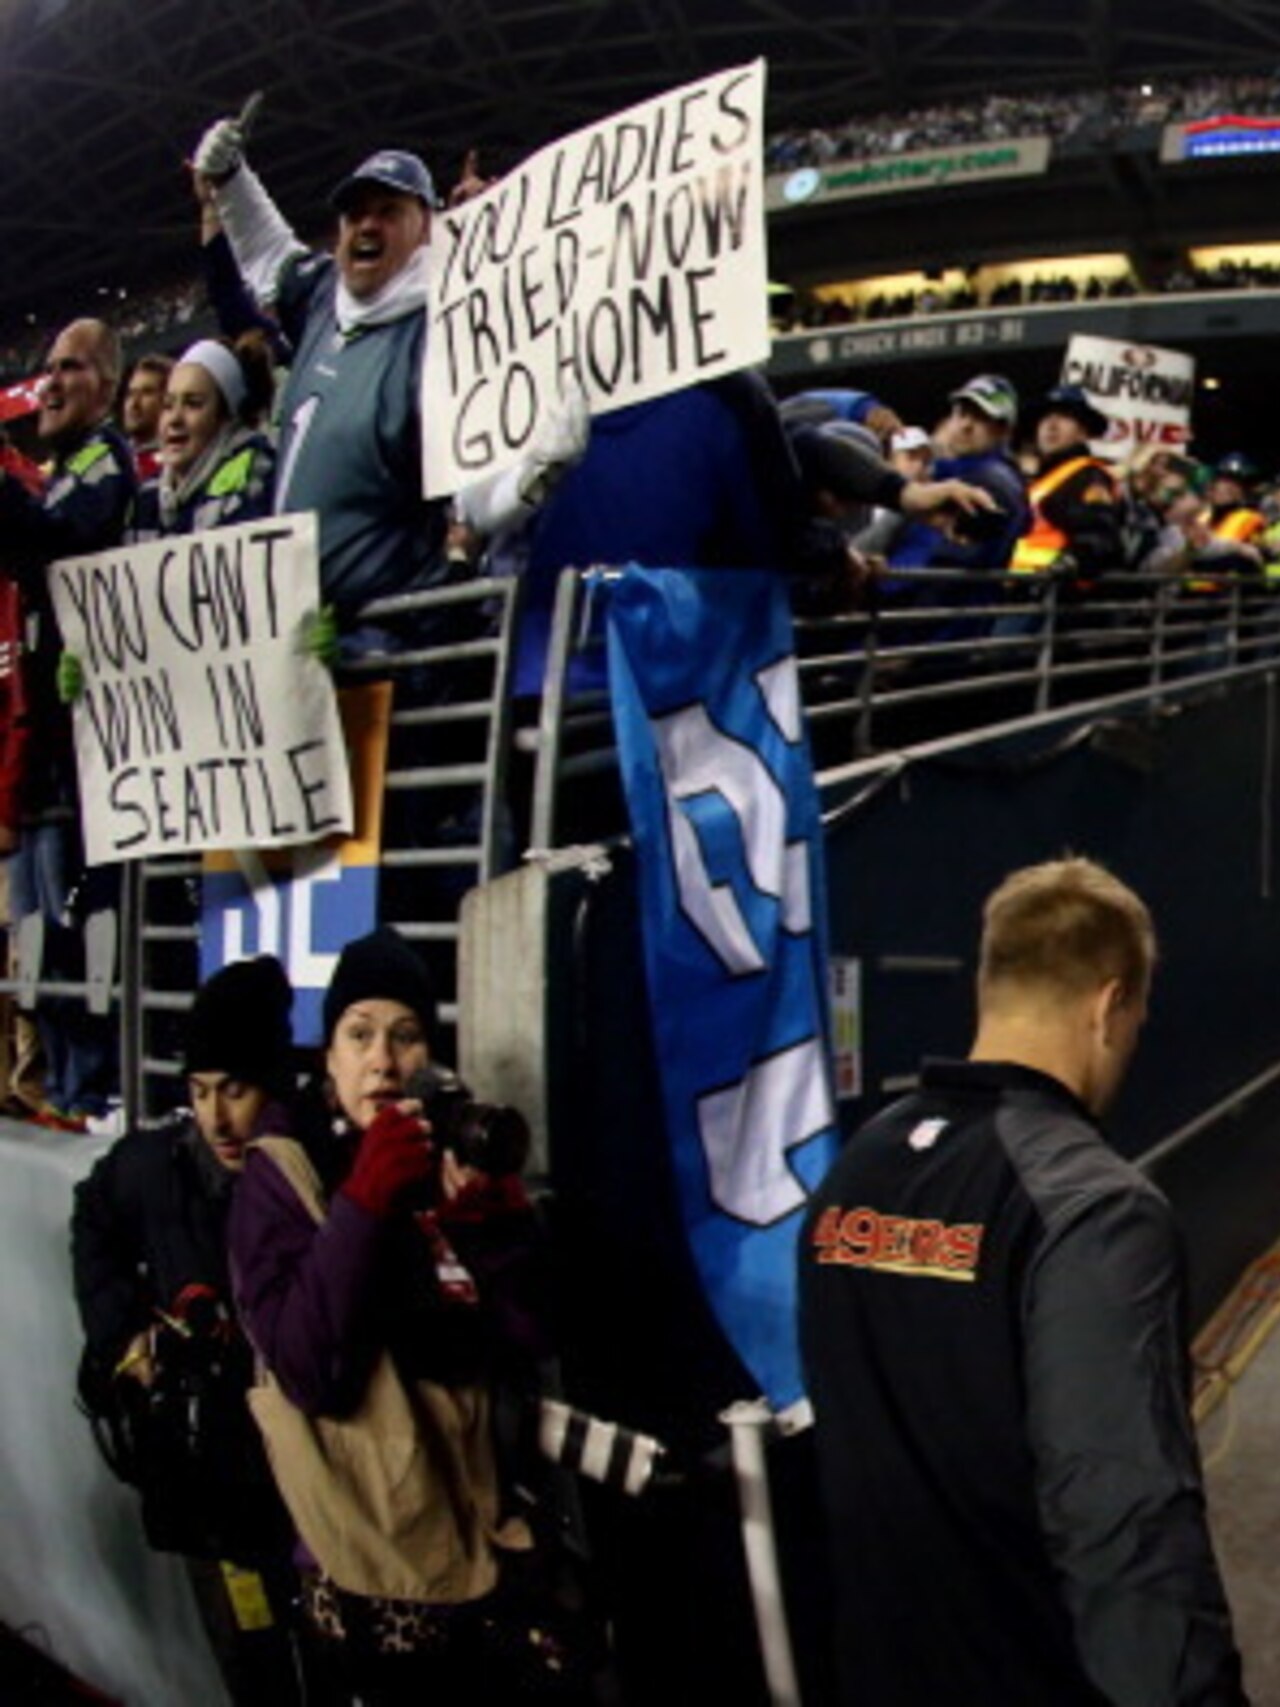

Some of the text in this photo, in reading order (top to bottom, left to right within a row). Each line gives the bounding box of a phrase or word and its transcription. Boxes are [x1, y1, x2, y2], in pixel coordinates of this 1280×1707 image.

[437, 72, 756, 303] YOU LADIES
[451, 267, 727, 471] GO HOME
[60, 528, 294, 676] YOU CANT
[84, 658, 265, 774] WIN IN
[109, 739, 343, 851] SEATTLE
[812, 1205, 984, 1272] 49ERS
